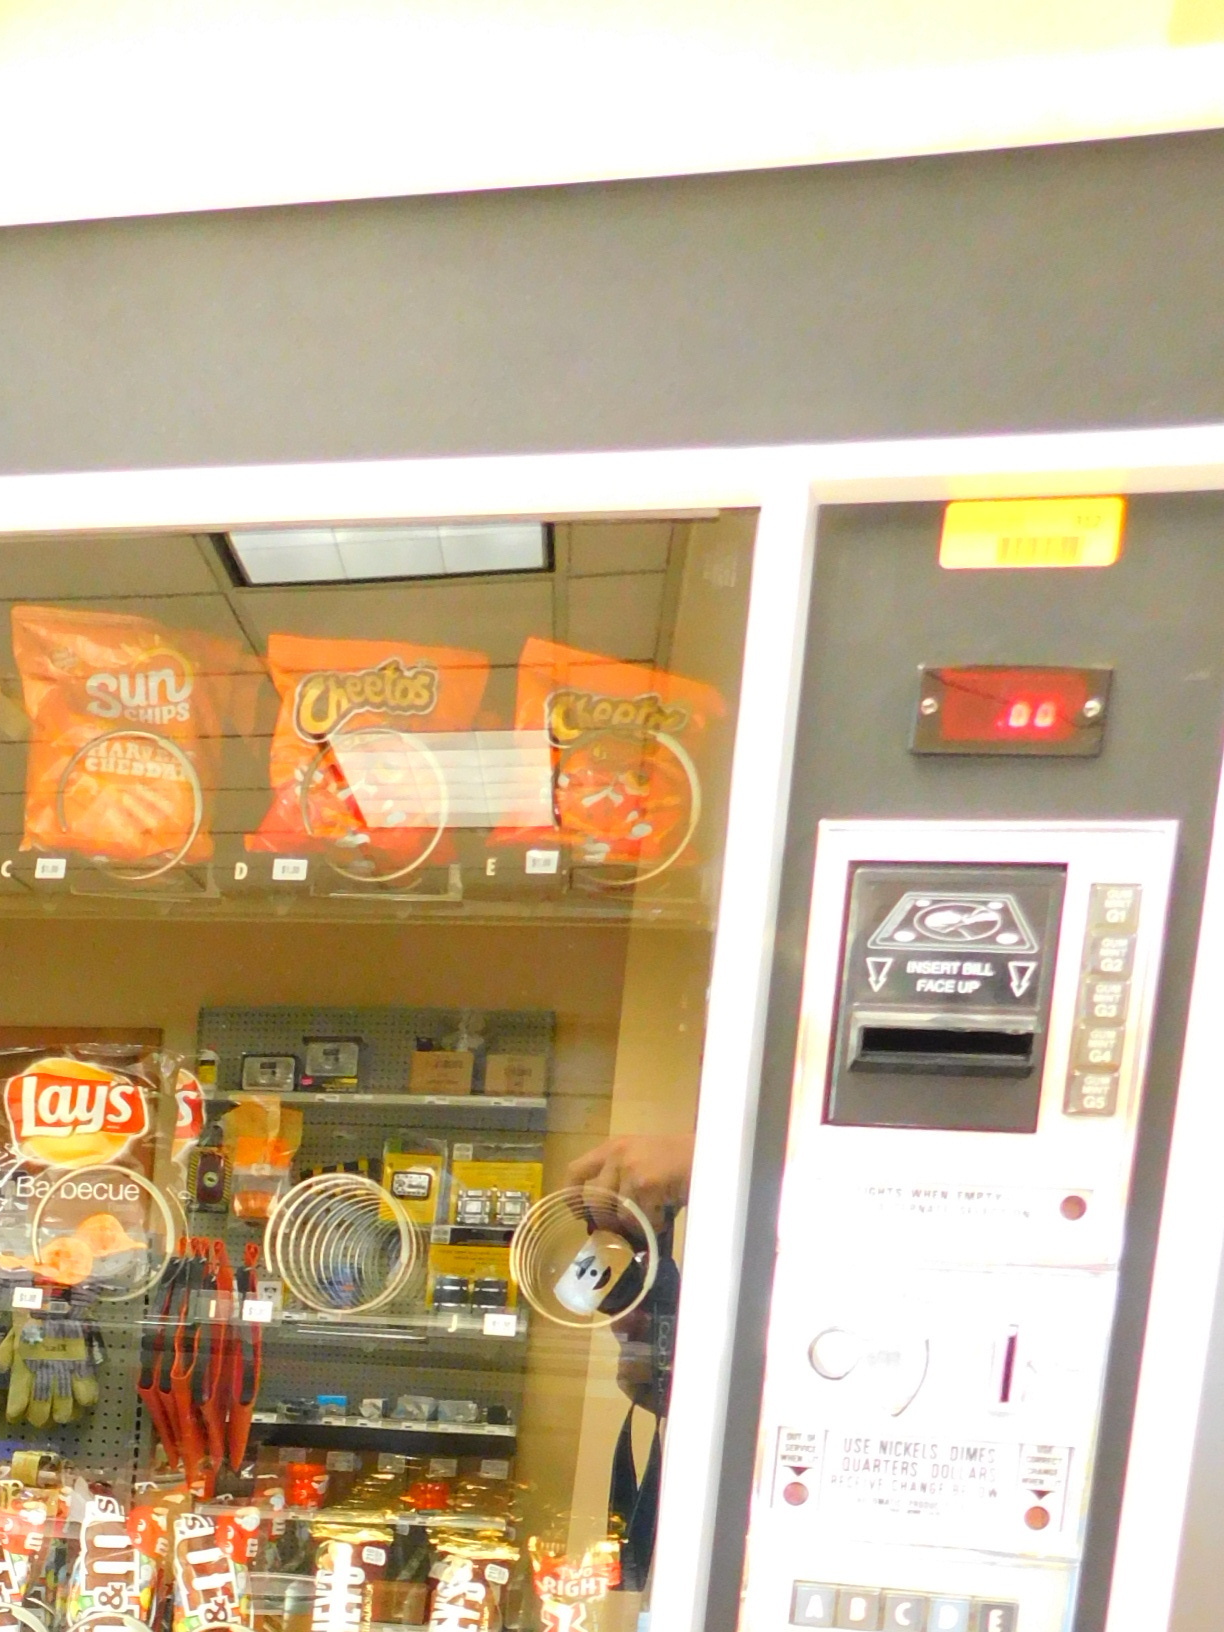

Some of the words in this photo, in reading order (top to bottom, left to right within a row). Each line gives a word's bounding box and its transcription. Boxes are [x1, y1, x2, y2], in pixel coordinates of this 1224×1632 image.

[297, 662, 434, 736] Cheetos
[125, 702, 190, 724] CHIPS
[1, 860, 13, 878] C
[234, 862, 248, 880] D
[486, 858, 497, 876] E
[1106, 910, 1126, 923] G1
[906, 960, 961, 975] INSERT
[962, 961, 995, 976] BILL
[1100, 958, 1123, 972] G2
[916, 979, 955, 993] FACE
[957, 980, 981, 994] UP
[1094, 1004, 1117, 1018] G3
[1089, 1050, 1111, 1063] G4
[20, 1075, 135, 1137] Lay's
[1083, 1096, 1105, 1109] G5
[16, 1175, 140, 1201] Babecue
[912, 1188, 948, 1200] WHEN
[957, 1190, 1003, 1201] EMPTY
[843, 1438, 870, 1454] USE
[879, 1440, 938, 1459] NICKELS
[950, 1446, 996, 1463] DIMES
[842, 1457, 918, 1477] QUARTERS
[931, 1463, 996, 1483] DOLLARS
[892, 1480, 944, 1495] CHANGE
[952, 1485, 998, 1498] BEOW
[542, 1576, 610, 1599] RIGHT
[805, 1595, 824, 1619] A
[850, 1597, 865, 1621] B
[895, 1602, 910, 1626] C
[939, 1605, 958, 1628] D
[988, 1609, 1003, 1632] E
